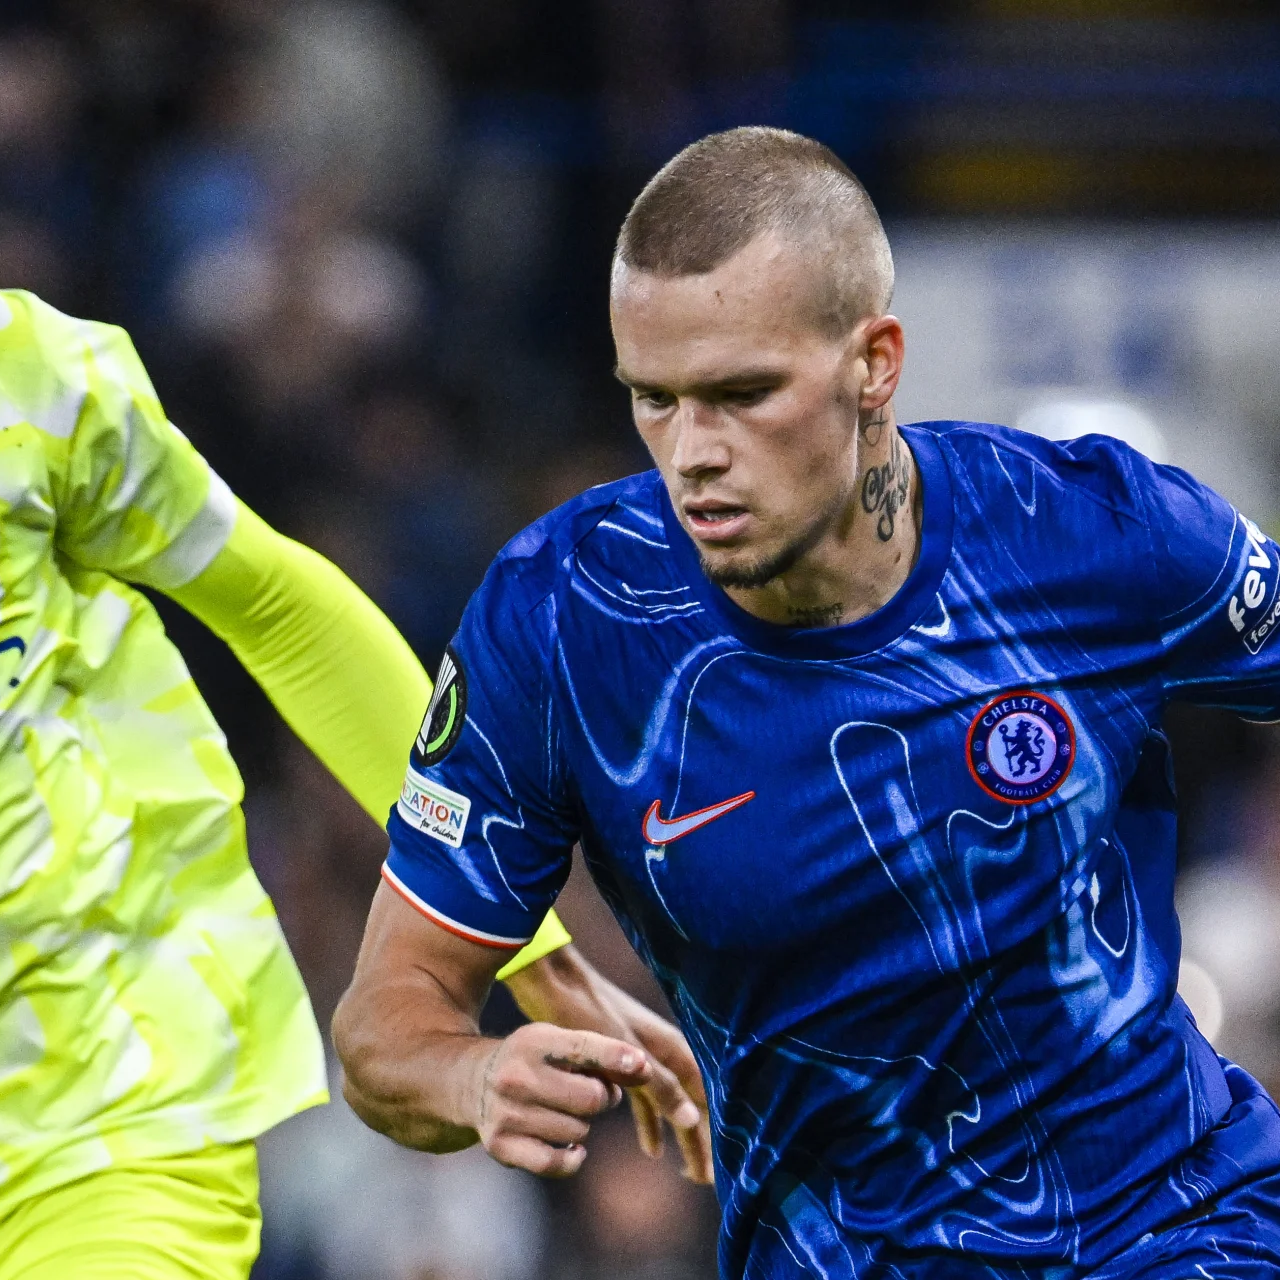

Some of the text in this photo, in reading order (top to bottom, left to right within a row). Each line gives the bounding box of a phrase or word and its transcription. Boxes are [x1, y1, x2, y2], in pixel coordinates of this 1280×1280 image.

[982, 698, 1048, 727] CHELSEA
[995, 769, 1061, 797] FOOTBALL CLUB
[420, 818, 457, 842] for children
